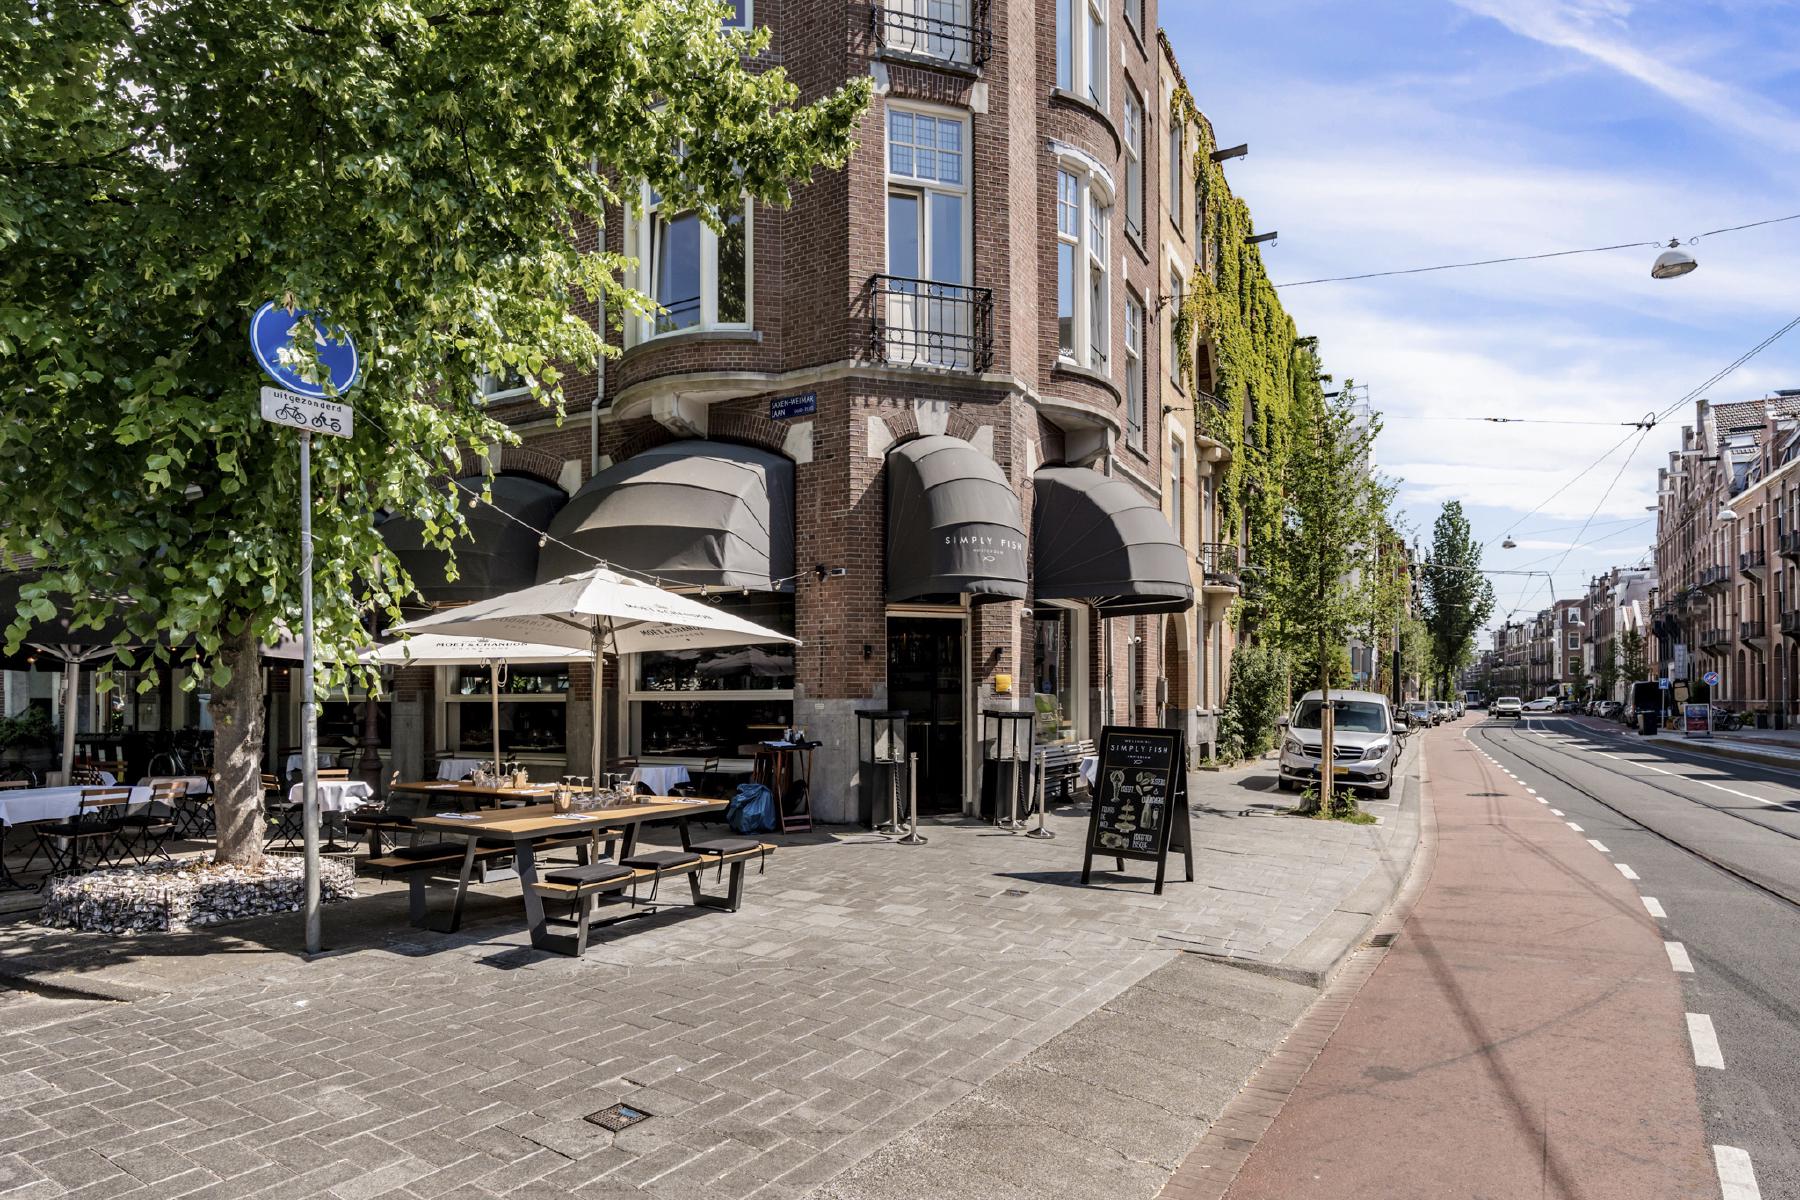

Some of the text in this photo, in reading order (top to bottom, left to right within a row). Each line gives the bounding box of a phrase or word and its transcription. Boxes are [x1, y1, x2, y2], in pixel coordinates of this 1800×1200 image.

[273, 391, 342, 412] uitgezonderd
[772, 395, 814, 410] SAXEN-WEIMAR
[772, 409, 786, 418] LAAN
[945, 536, 1022, 551] SIMPLY FISH
[1110, 744, 1168, 754] SIMPLY FISH
